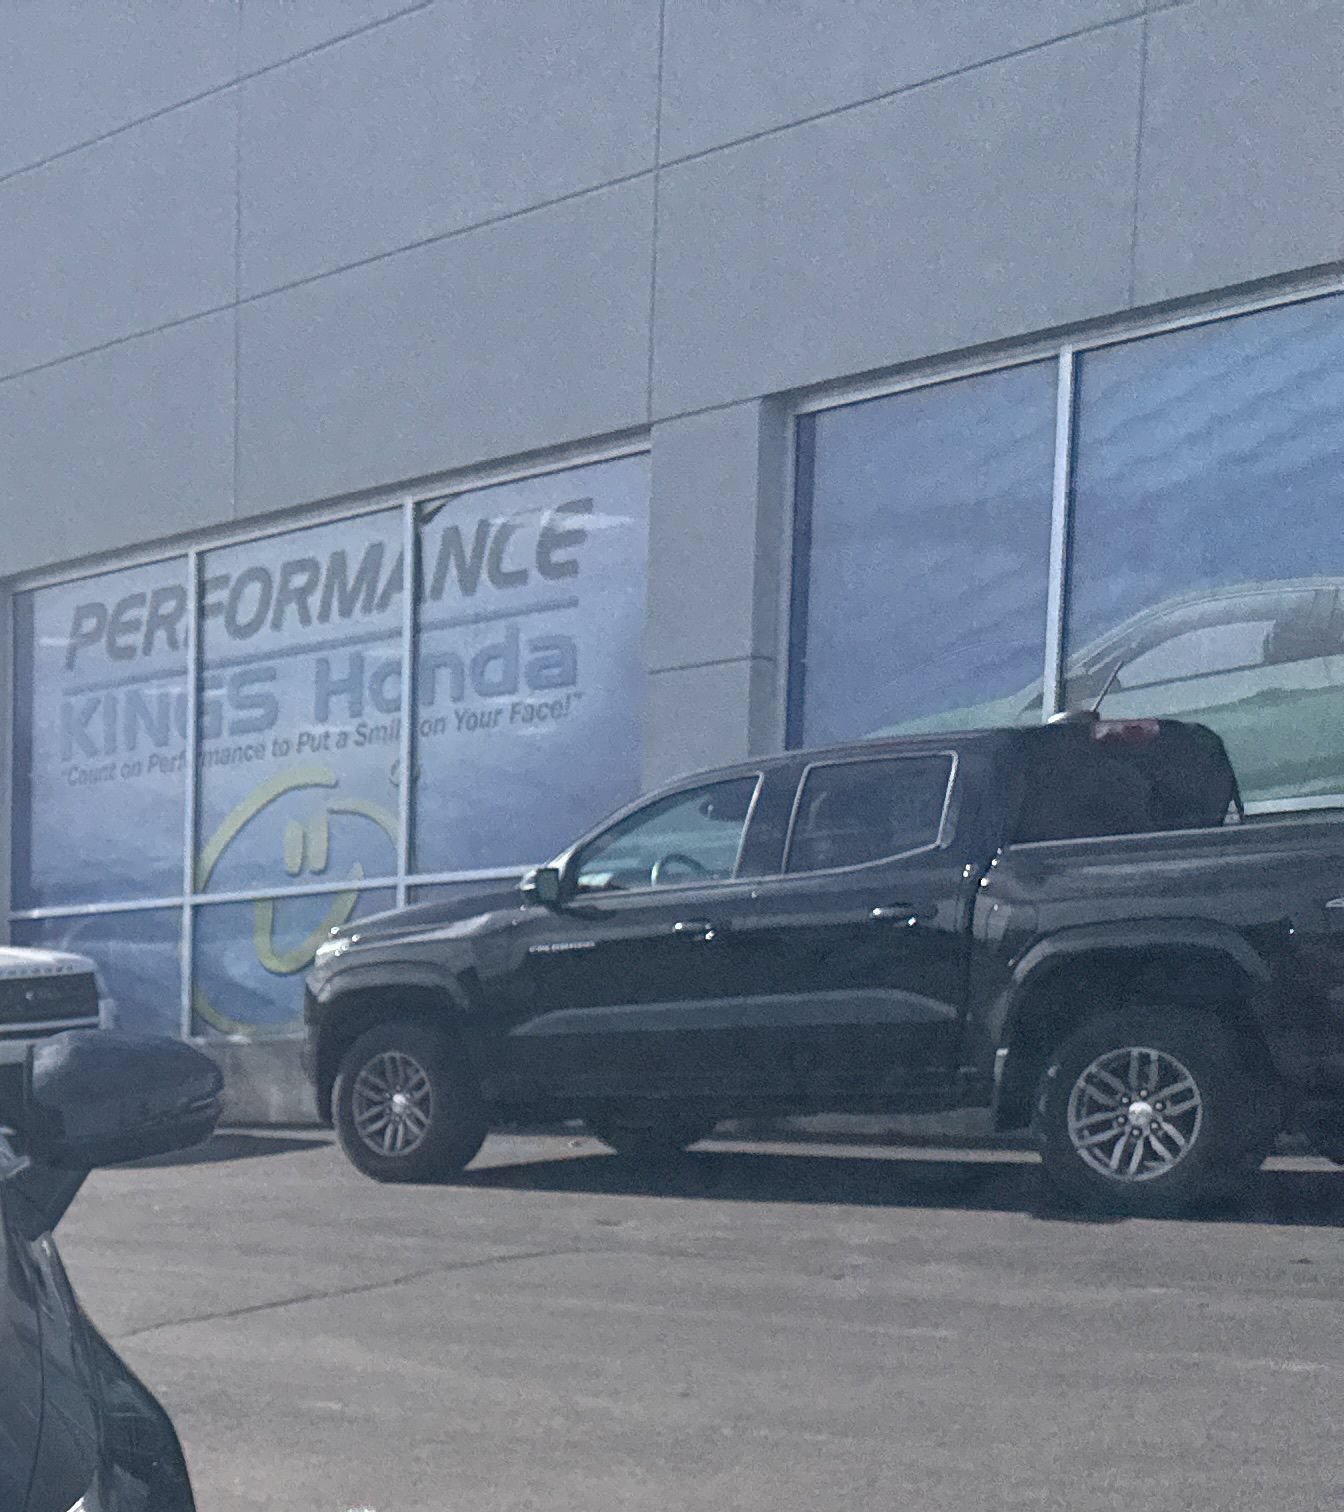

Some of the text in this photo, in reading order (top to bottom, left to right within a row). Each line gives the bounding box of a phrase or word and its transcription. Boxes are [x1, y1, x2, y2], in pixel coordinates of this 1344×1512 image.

[66, 498, 593, 672] PERFORMANCE
[62, 624, 578, 762] KINGS Honda
[120, 761, 142, 779] on
[271, 737, 290, 757] to
[296, 728, 331, 753] Put
[335, 731, 348, 749] a
[353, 717, 406, 747] Smil
[419, 715, 446, 738] on
[454, 707, 503, 732] Your
